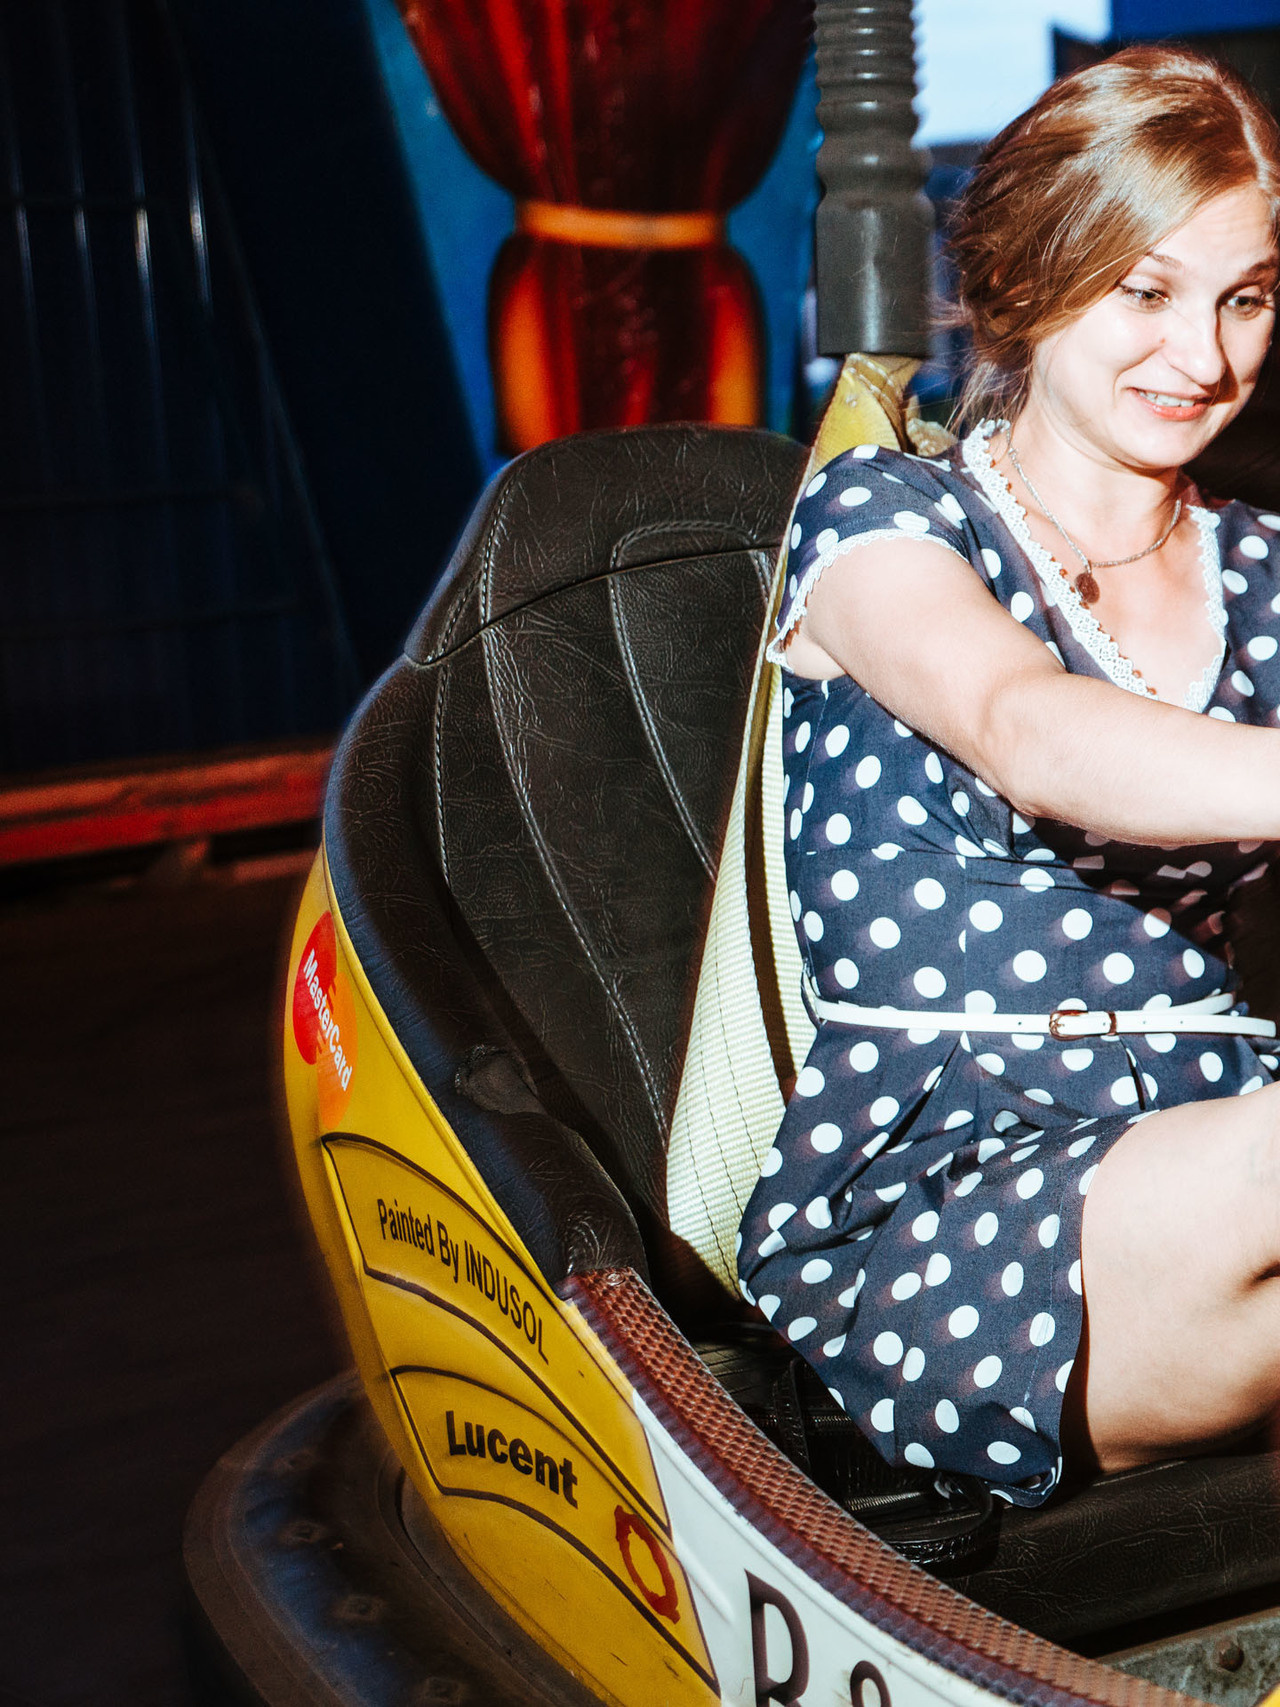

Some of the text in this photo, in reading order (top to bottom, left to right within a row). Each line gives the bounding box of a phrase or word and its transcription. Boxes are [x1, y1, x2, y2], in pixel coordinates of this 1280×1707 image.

[303, 948, 353, 1091] MasterCard
[377, 1198, 549, 1366] Painted By INDUSOL
[446, 1410, 578, 1510] Lucent
